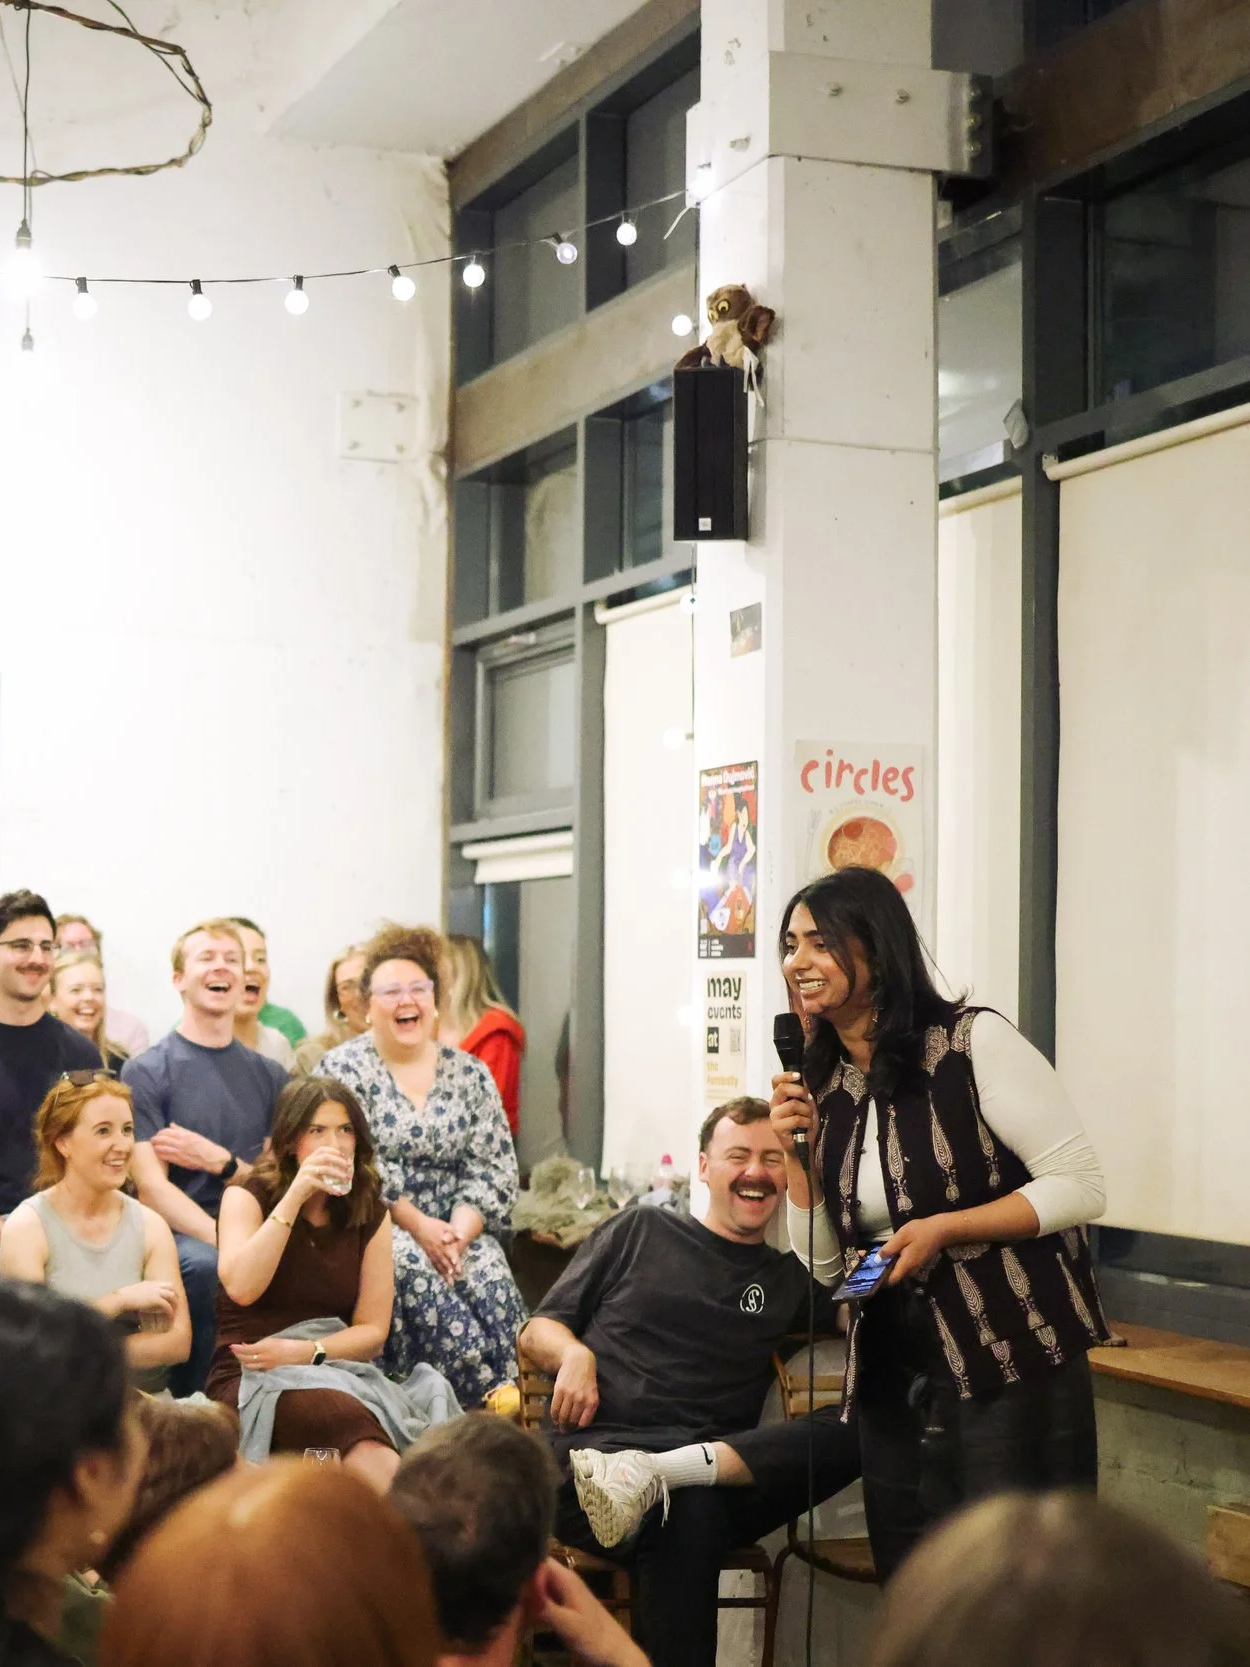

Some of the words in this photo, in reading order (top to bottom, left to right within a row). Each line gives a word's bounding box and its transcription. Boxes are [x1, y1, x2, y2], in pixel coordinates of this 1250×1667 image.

[801, 749, 915, 802] circles
[707, 977, 741, 1001] may
[707, 1004, 742, 1020] events
[707, 1030, 719, 1048] at
